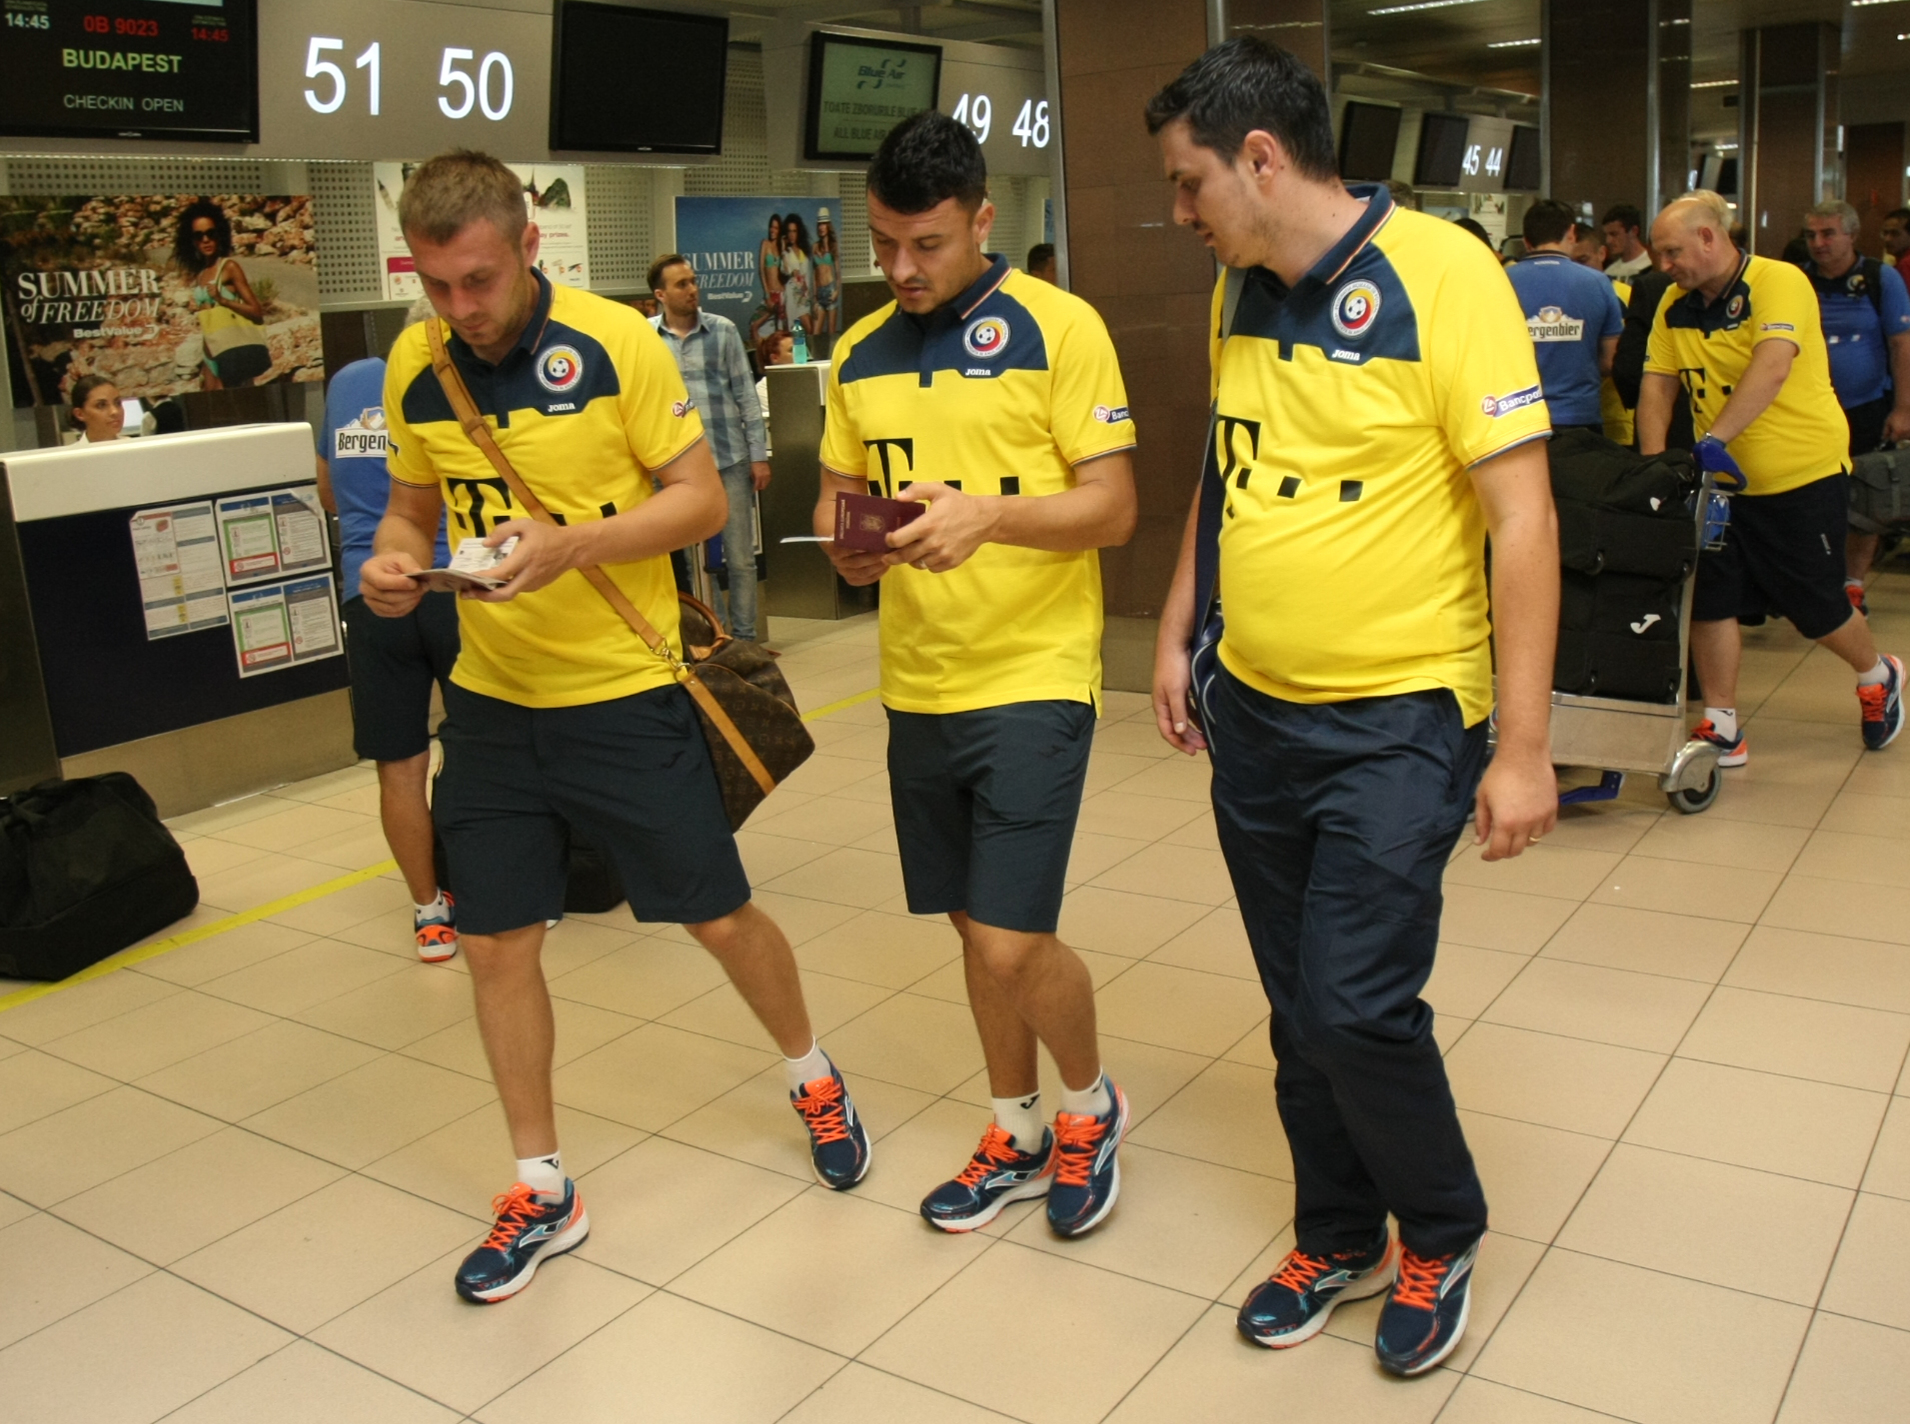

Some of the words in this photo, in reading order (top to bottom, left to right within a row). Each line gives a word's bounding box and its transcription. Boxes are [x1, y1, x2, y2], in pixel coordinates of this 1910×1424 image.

[4, 12, 50, 29] 14:45
[115, 17, 158, 37] 9023
[191, 27, 229, 42] 14:45
[62, 48, 182, 73] BUDAPEST
[304, 37, 380, 116] 51
[438, 47, 513, 121] 50
[63, 94, 134, 110] CHECKIN
[142, 97, 184, 112] OPEN
[823, 100, 851, 115] TOATE
[1012, 99, 1049, 149] 48
[1462, 144, 1481, 176] 45
[1485, 146, 1503, 177] 44
[17, 268, 162, 300] SUMMER
[20, 295, 43, 323] of
[38, 297, 162, 325] FREEDOM
[73, 326, 143, 339] BestValue
[1527, 322, 1580, 339] ergenbier
[1111, 410, 1130, 420] Banc
[338, 432, 387, 454] Bergen
